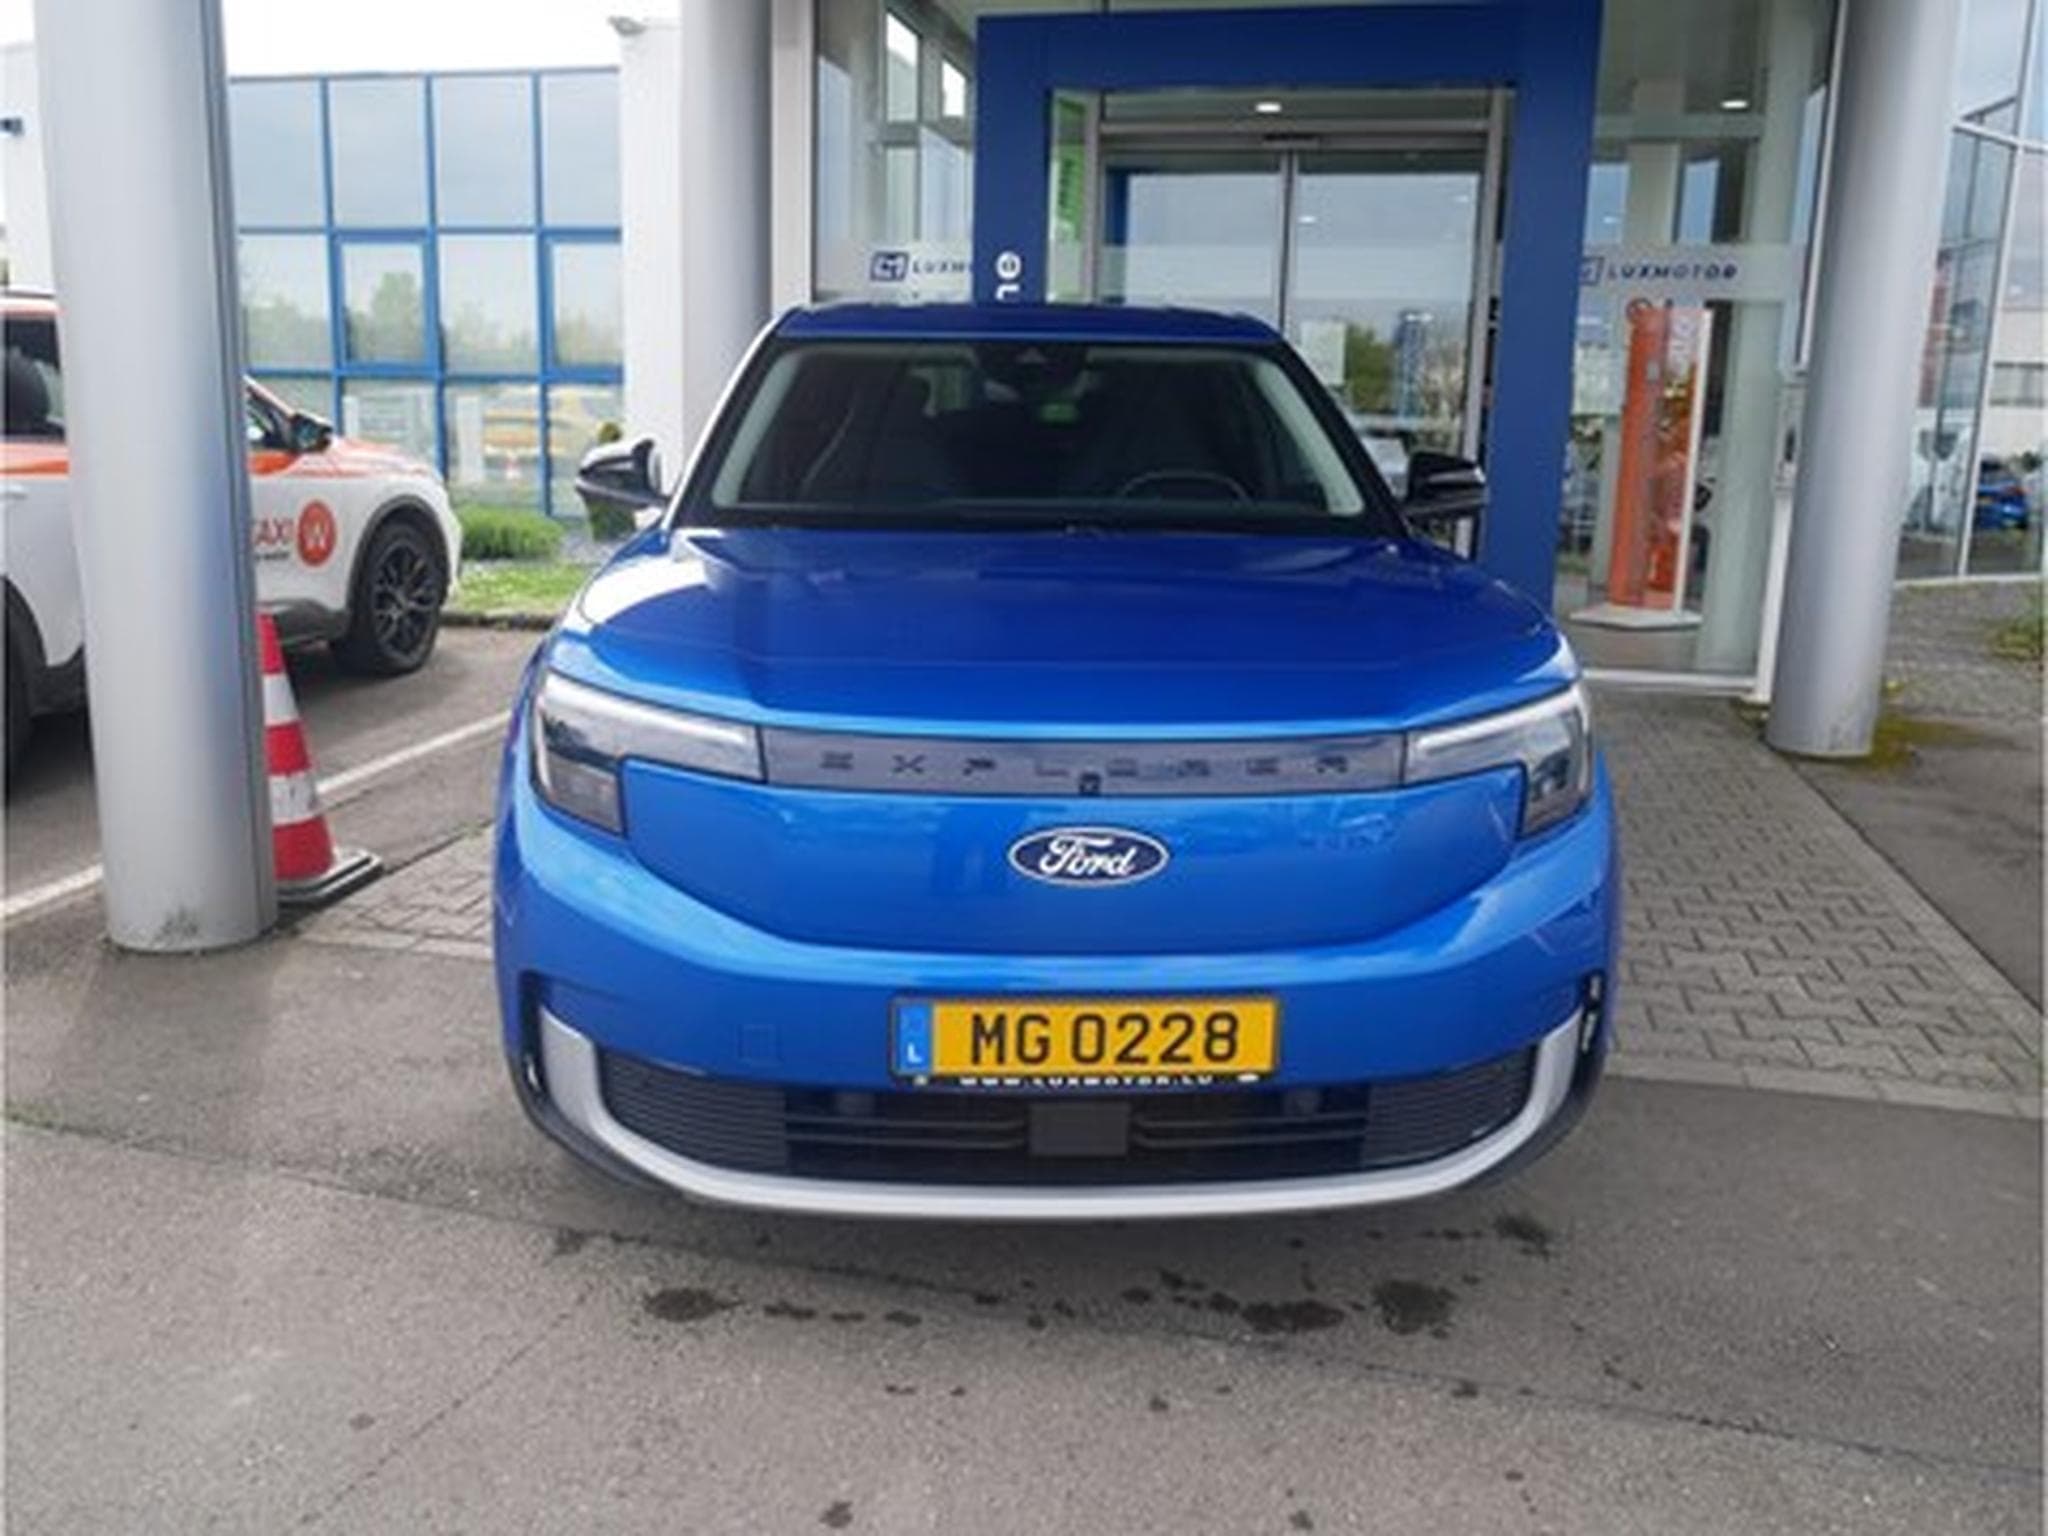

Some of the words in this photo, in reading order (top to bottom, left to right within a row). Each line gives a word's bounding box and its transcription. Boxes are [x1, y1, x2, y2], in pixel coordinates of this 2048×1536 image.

[1039, 836, 1138, 875] Ford
[972, 1013, 1051, 1064] MG
[1072, 1012, 1239, 1064] 0228
